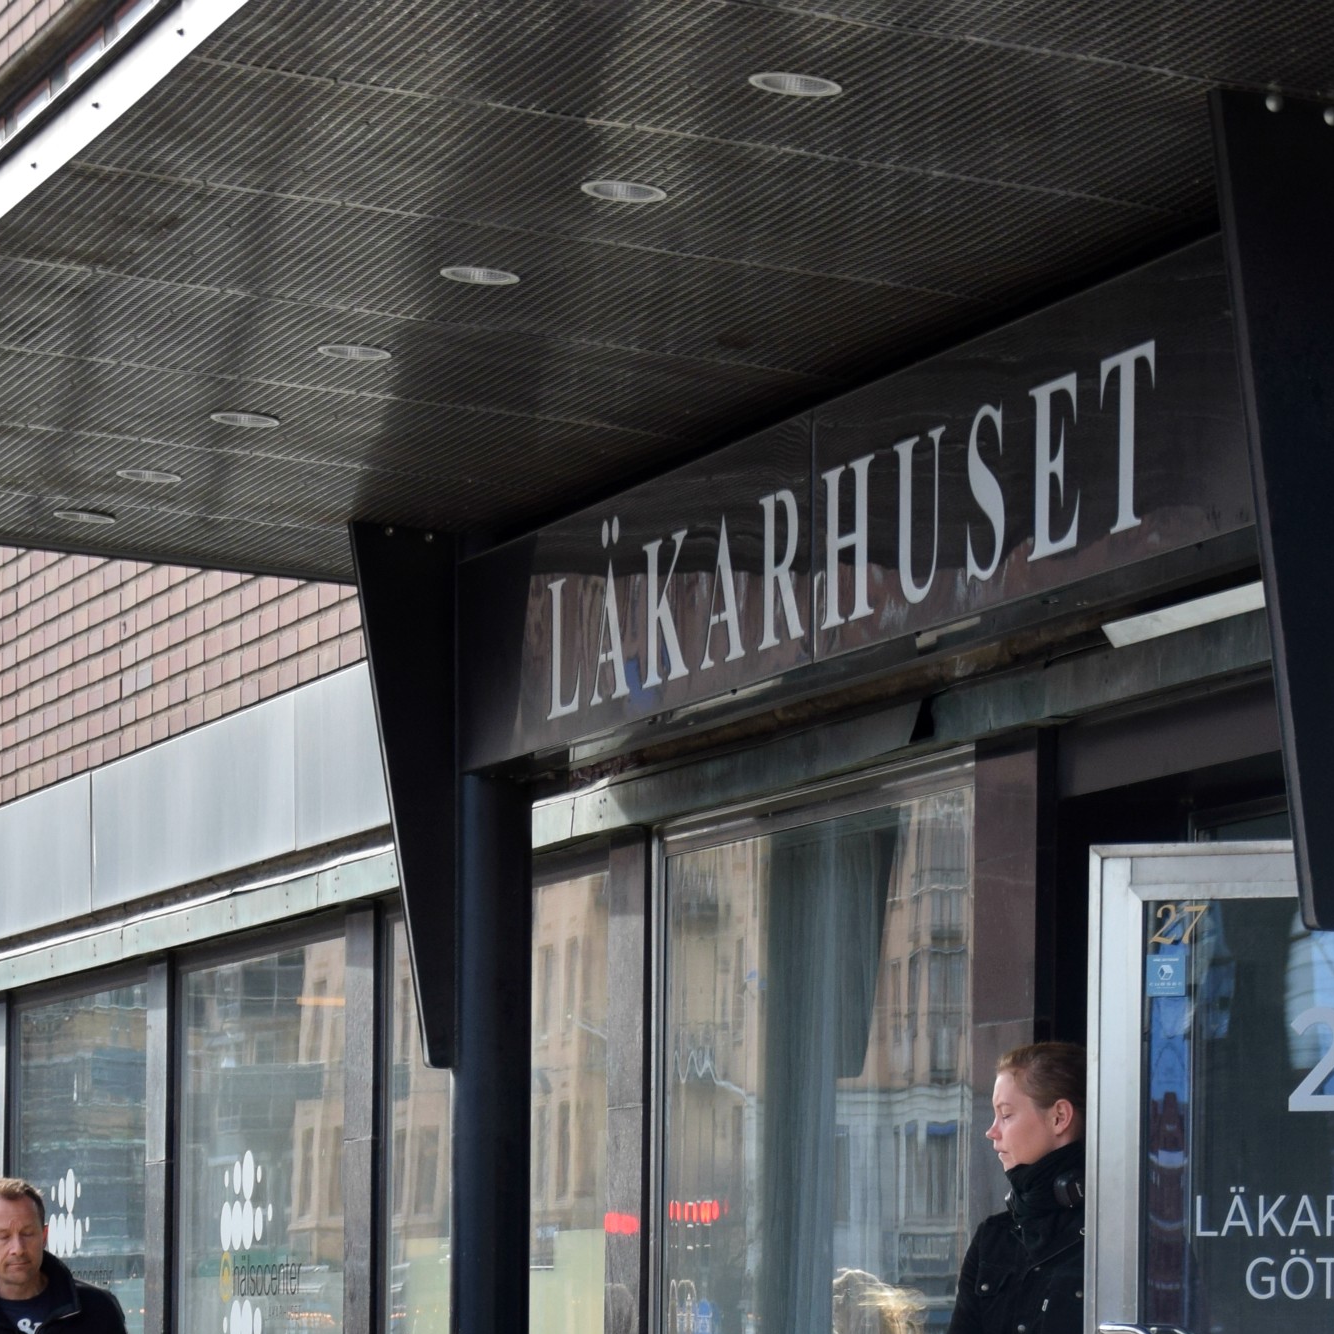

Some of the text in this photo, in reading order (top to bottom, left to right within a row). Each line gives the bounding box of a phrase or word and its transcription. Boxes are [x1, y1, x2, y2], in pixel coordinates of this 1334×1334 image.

[547, 339, 1157, 720] LÄKARHUSET
[1148, 904, 1208, 945] 27
[232, 1254, 302, 1298] hälsocenter
